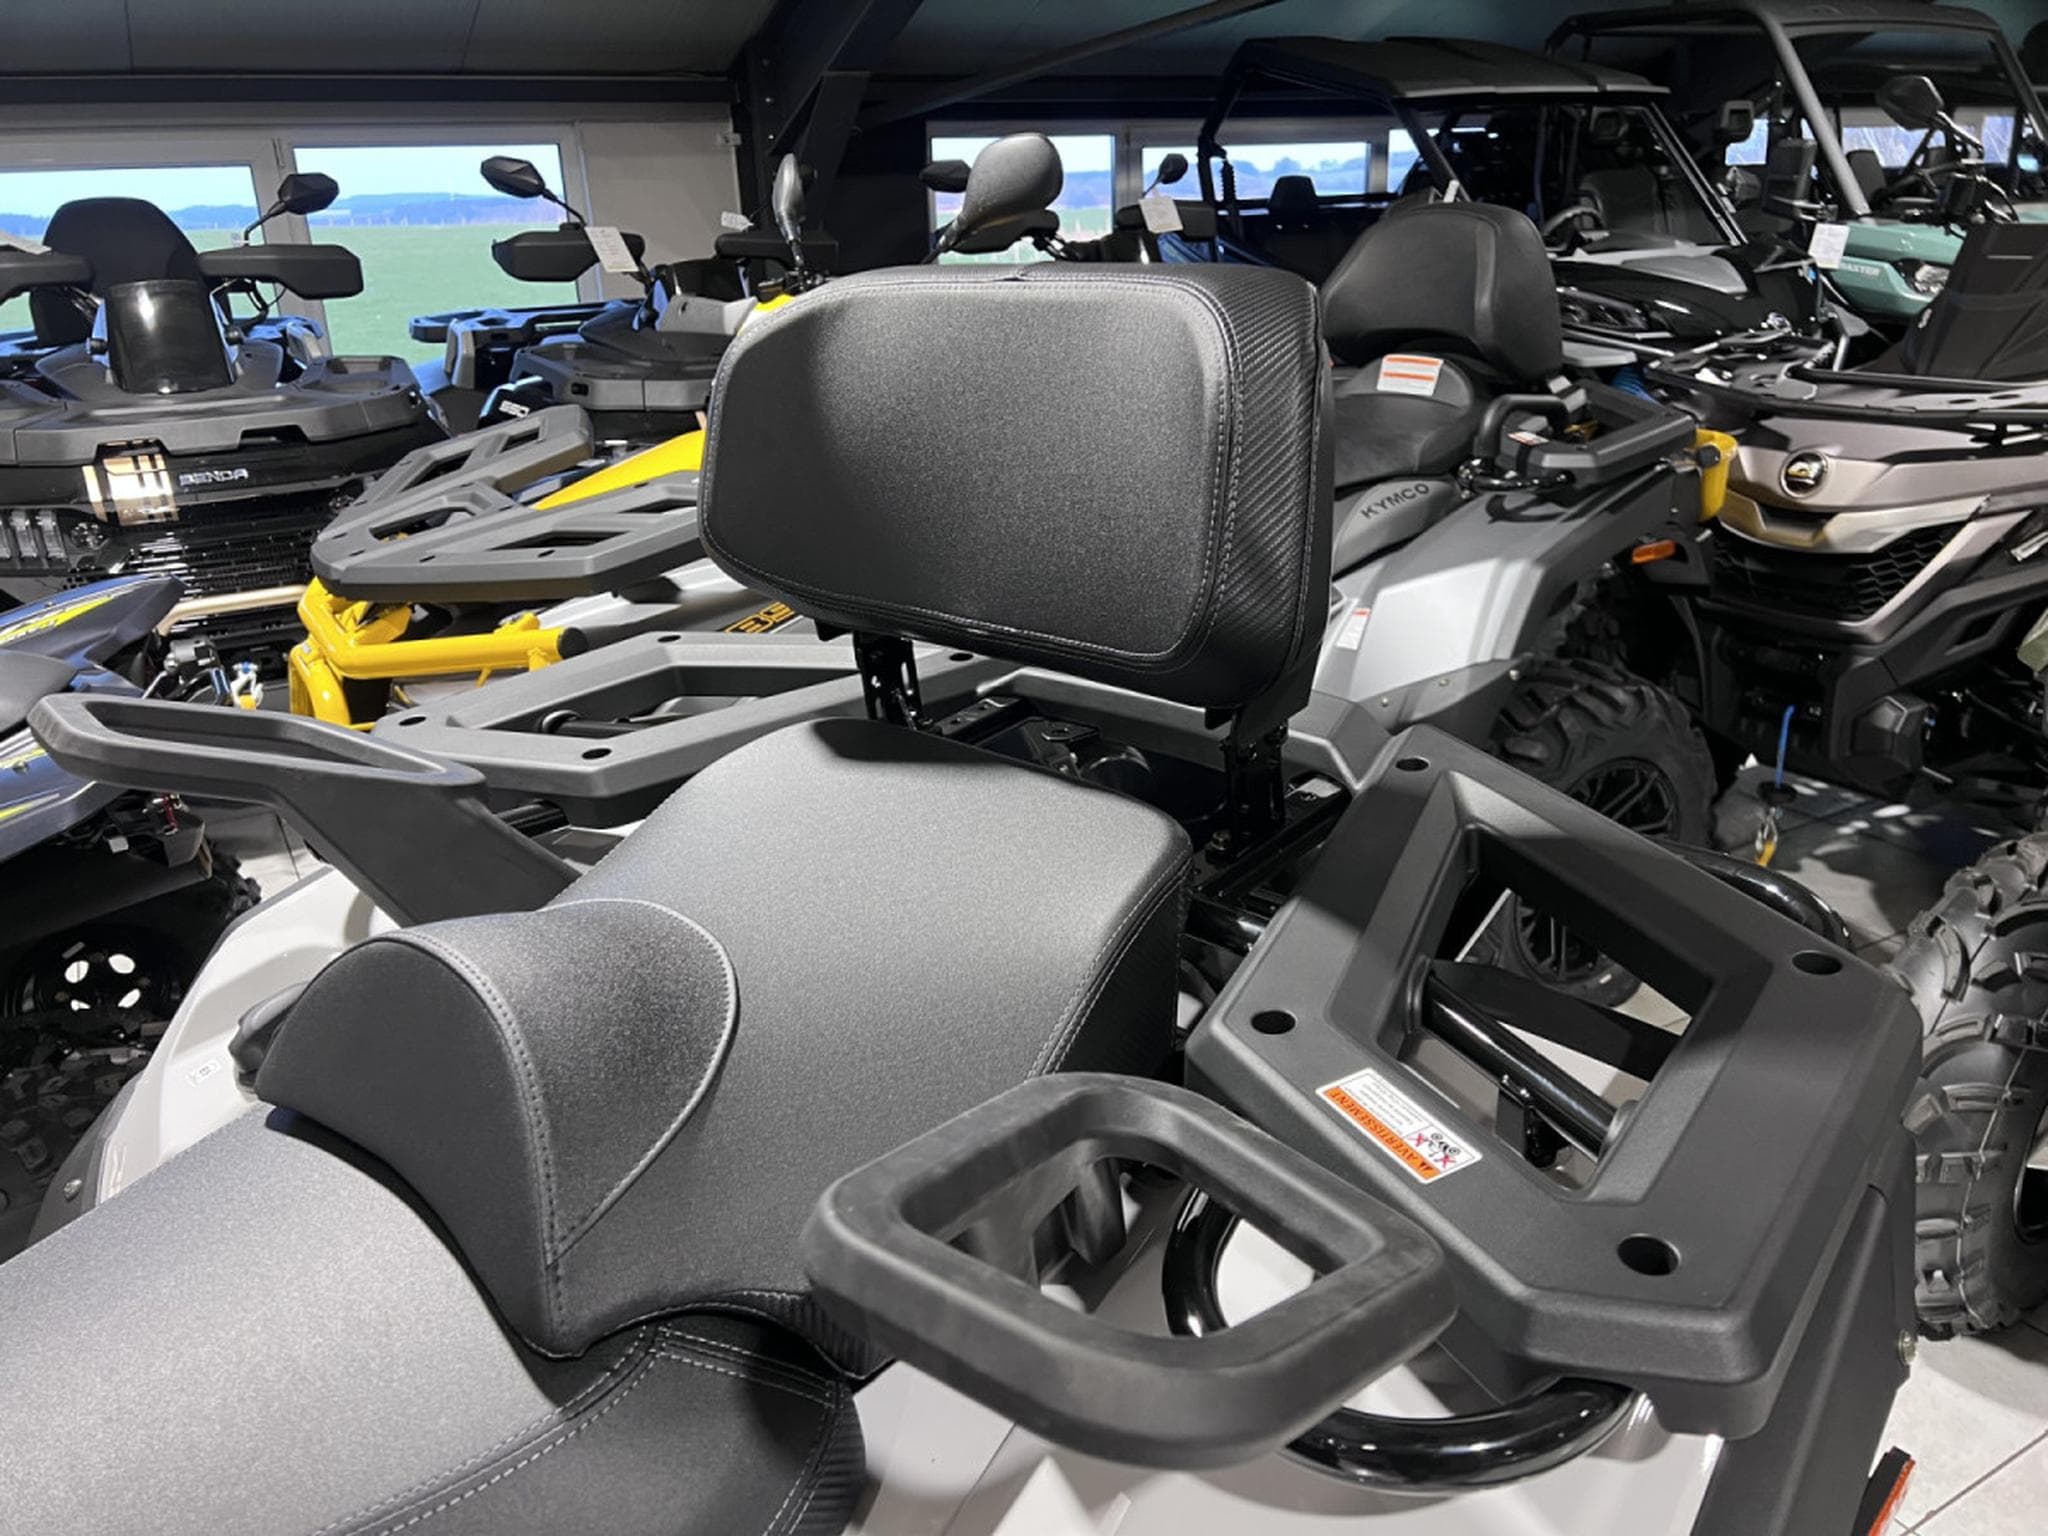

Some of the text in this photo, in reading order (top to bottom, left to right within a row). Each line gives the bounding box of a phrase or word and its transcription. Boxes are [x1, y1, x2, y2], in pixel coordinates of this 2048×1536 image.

[1839, 262, 1880, 277] AXTER
[179, 468, 249, 487] BENDA
[1361, 483, 1429, 519] KYMCO
[1330, 1091, 1418, 1162] AVERTISSEMENT
